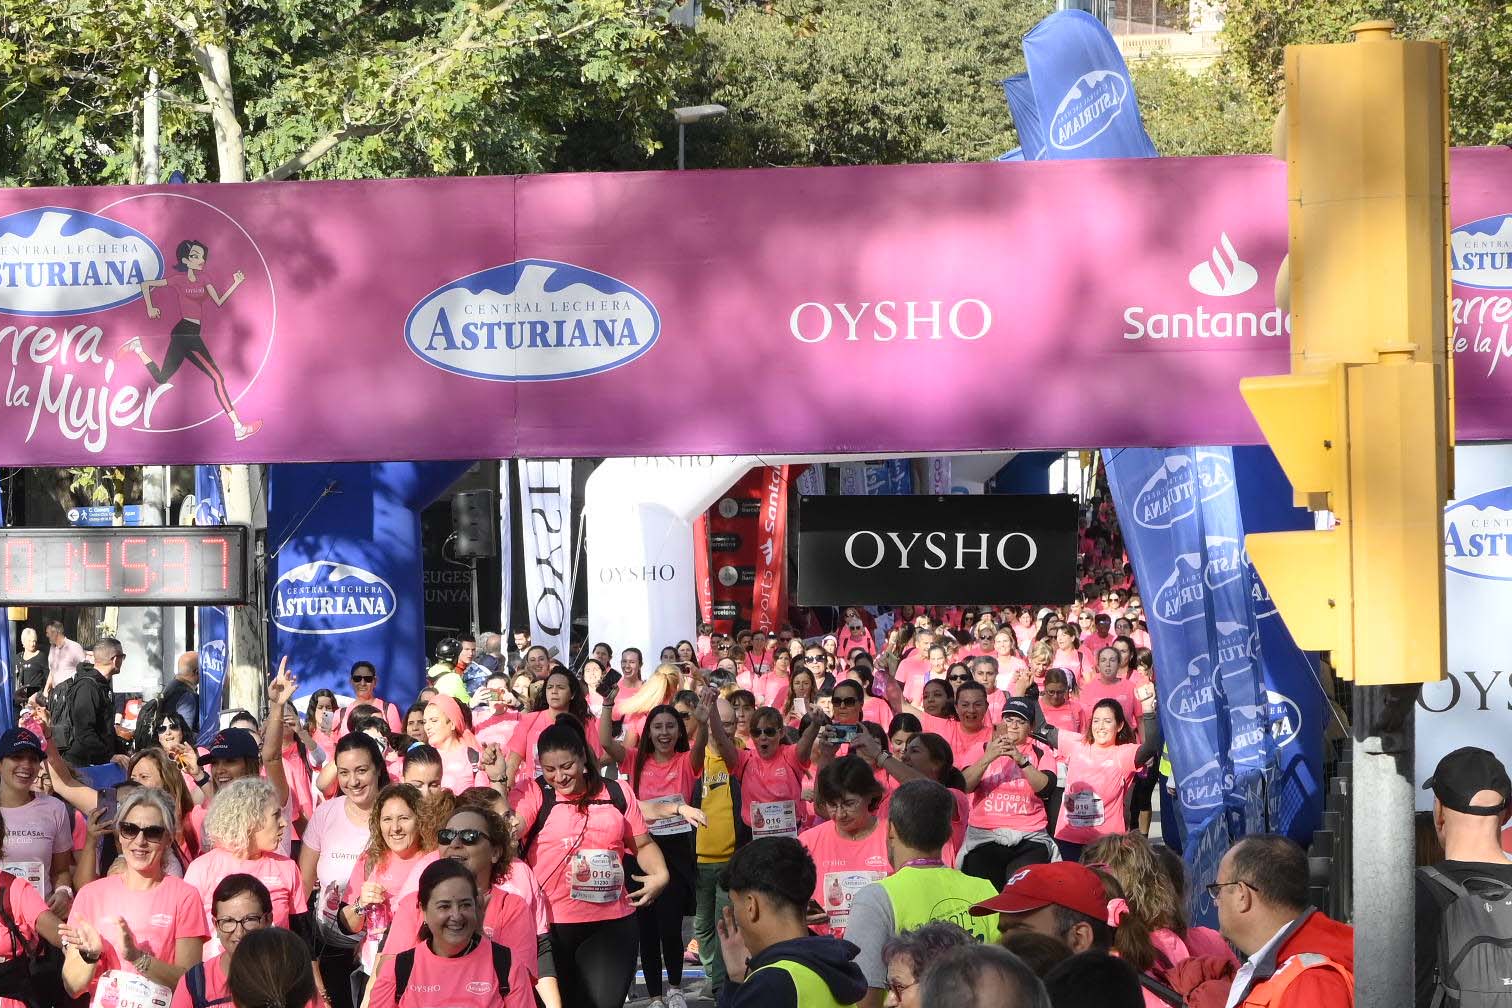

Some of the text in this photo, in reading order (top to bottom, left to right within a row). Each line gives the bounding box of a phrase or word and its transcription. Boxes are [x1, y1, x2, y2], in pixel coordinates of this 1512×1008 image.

[67, 243, 139, 255] LECHERA
[1464, 241, 1512, 249] CENTRA
[464, 300, 633, 315] CENTRAL LECHERA
[424, 307, 640, 351] ASTURIANA
[789, 299, 993, 344] OYSHO
[1474, 324, 1492, 352] la
[5, 367, 29, 407] la
[25, 359, 174, 453] Mujer
[844, 529, 1038, 571] OYSHO
[5, 537, 231, 594] 01:45:37
[599, 564, 675, 585] OYSHO
[287, 585, 383, 596] CENTRAL LECHERA
[275, 590, 388, 617] ASTURIANA
[984, 801, 1029, 814] SUMA
[766, 817, 782, 825] 016
[592, 870, 611, 879] 016
